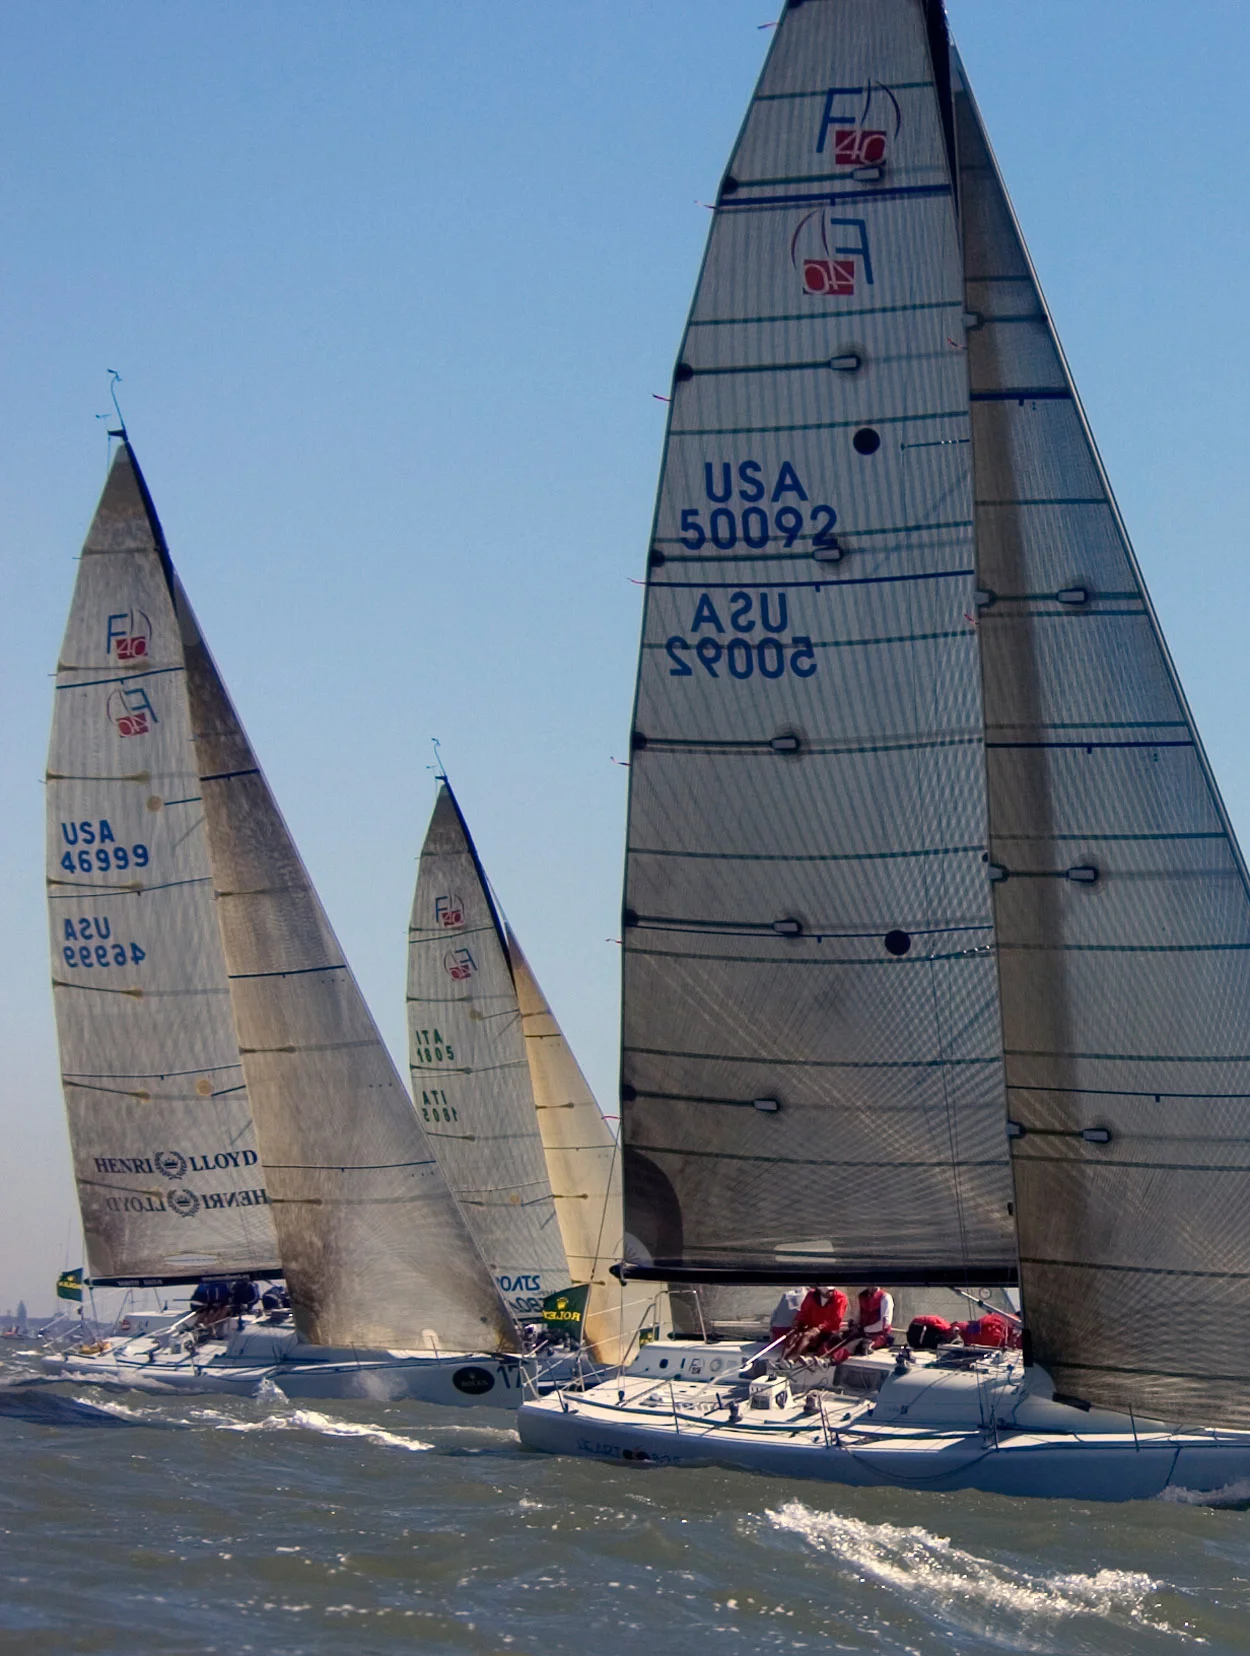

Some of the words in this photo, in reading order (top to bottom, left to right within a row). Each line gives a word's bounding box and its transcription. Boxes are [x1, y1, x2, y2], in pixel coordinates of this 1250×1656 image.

[704, 460, 808, 503] USA
[680, 504, 838, 550] 50092
[61, 819, 115, 846] USA
[60, 843, 149, 874] 46999
[415, 1028, 443, 1045] ITA
[416, 1045, 454, 1063] 1805
[94, 1157, 153, 1173] HENRI
[189, 1149, 258, 1171] LLOYD
